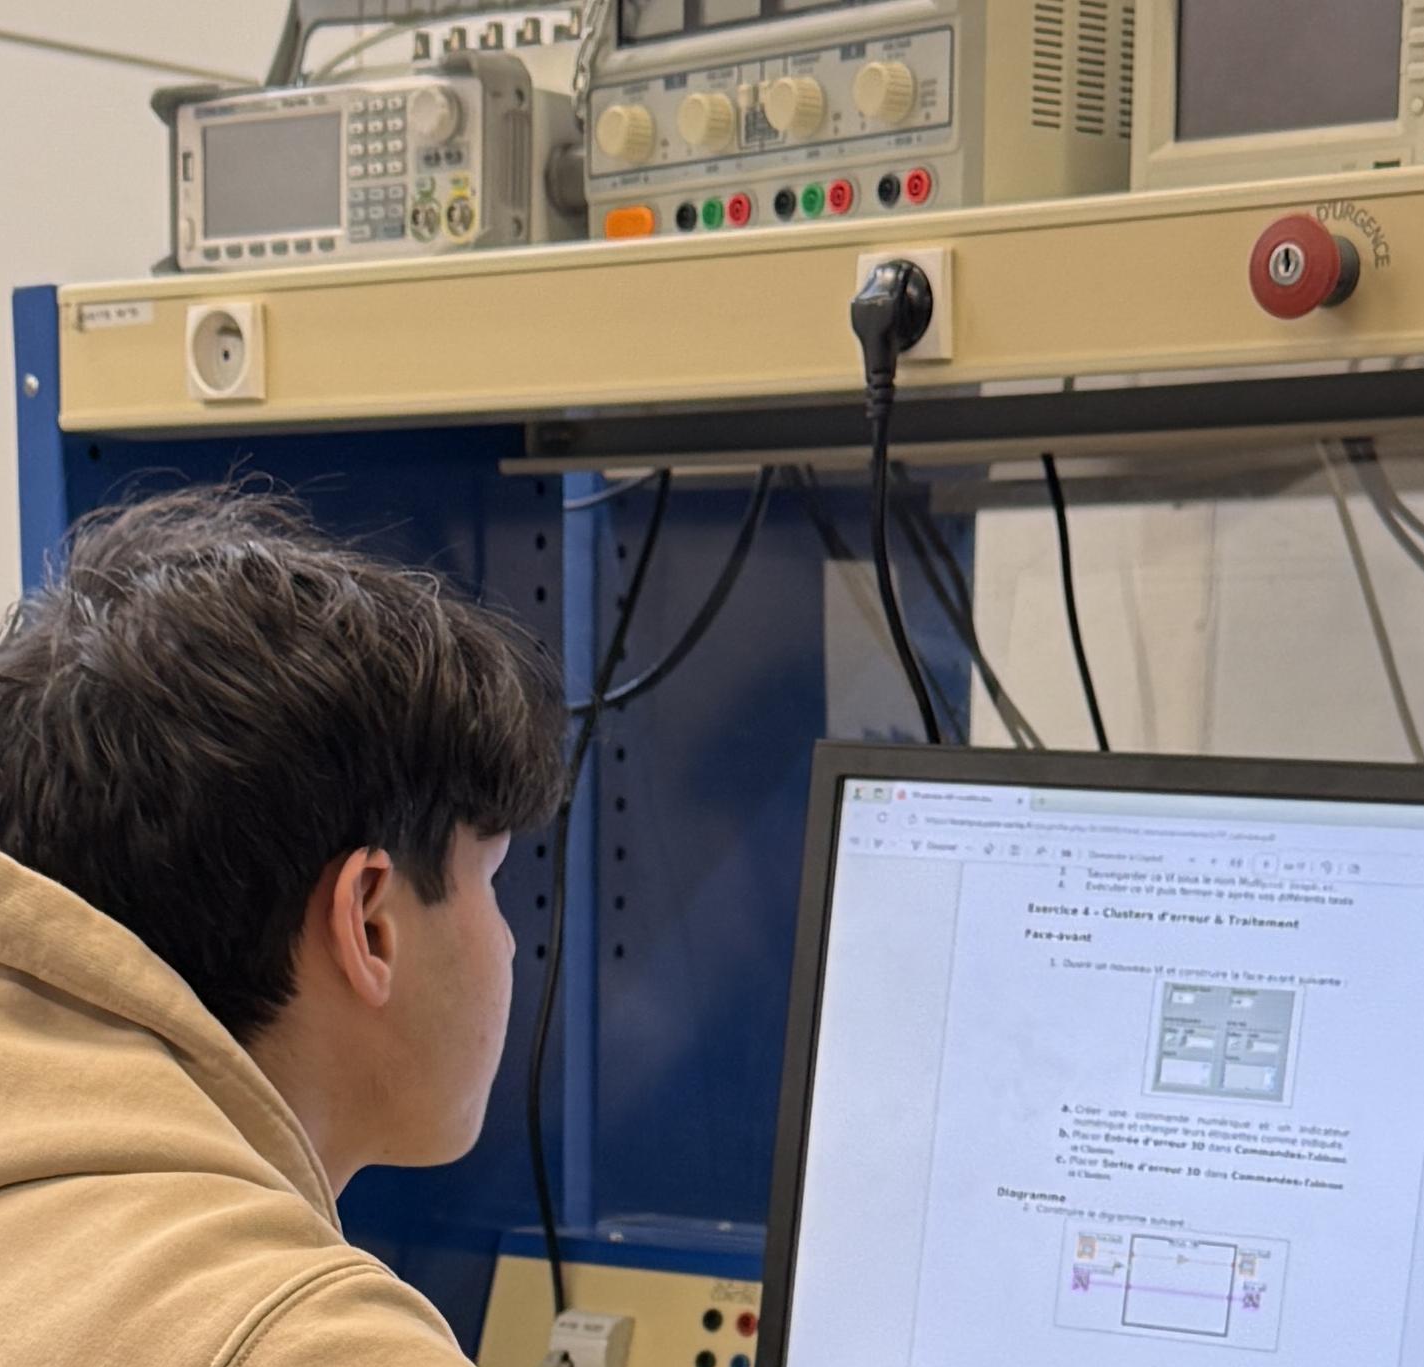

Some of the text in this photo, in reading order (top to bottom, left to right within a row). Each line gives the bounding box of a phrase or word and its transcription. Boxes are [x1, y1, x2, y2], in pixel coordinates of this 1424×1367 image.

[1316, 201, 1391, 269] D'URGENCE
[1028, 903, 1079, 916] Exercice
[1082, 906, 1090, 916] 4
[1102, 907, 1153, 921] Clusters
[1158, 911, 1211, 925] d'erreur
[1214, 915, 1224, 926] &
[1228, 914, 1299, 930] Traitement
[1025, 928, 1092, 943] Face-avant
[1135, 1112, 1189, 1123] commande
[1139, 1122, 1179, 1136] changer
[1104, 1132, 1139, 1145] Entrée
[1142, 1137, 1187, 1149] d'erreur
[1208, 1143, 1232, 1153] dans
[1102, 1158, 1134, 1170] Sortie
[1137, 1163, 1183, 1175] d'erreur
[1204, 1168, 1228, 1180] dans
[997, 1186, 1066, 1203] Diagramme
[1036, 1204, 1085, 1217] Construire
